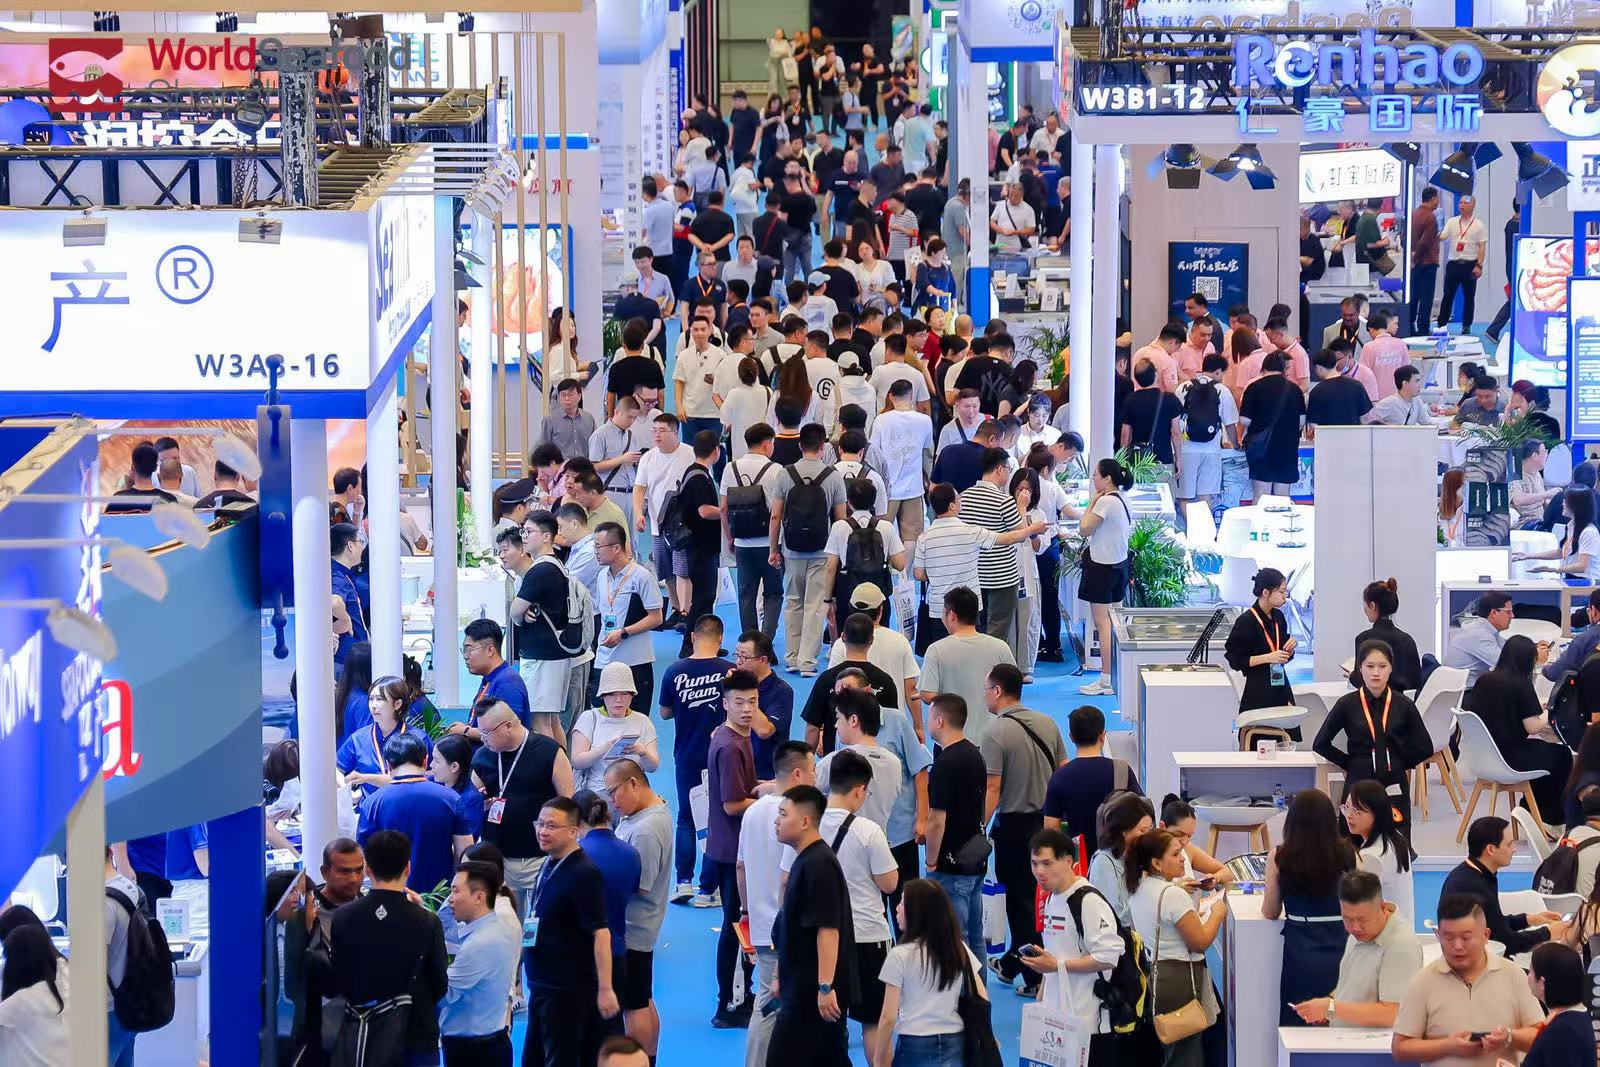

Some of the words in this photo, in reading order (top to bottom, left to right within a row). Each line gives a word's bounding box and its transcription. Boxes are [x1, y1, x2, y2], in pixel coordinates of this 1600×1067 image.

[1082, 87, 1204, 110] W3B1-12
[1235, 94, 1482, 134] 仁豪国际
[41, 258, 130, 352] 产
[674, 673, 724, 691] Puma
[679, 686, 720, 703] Team
